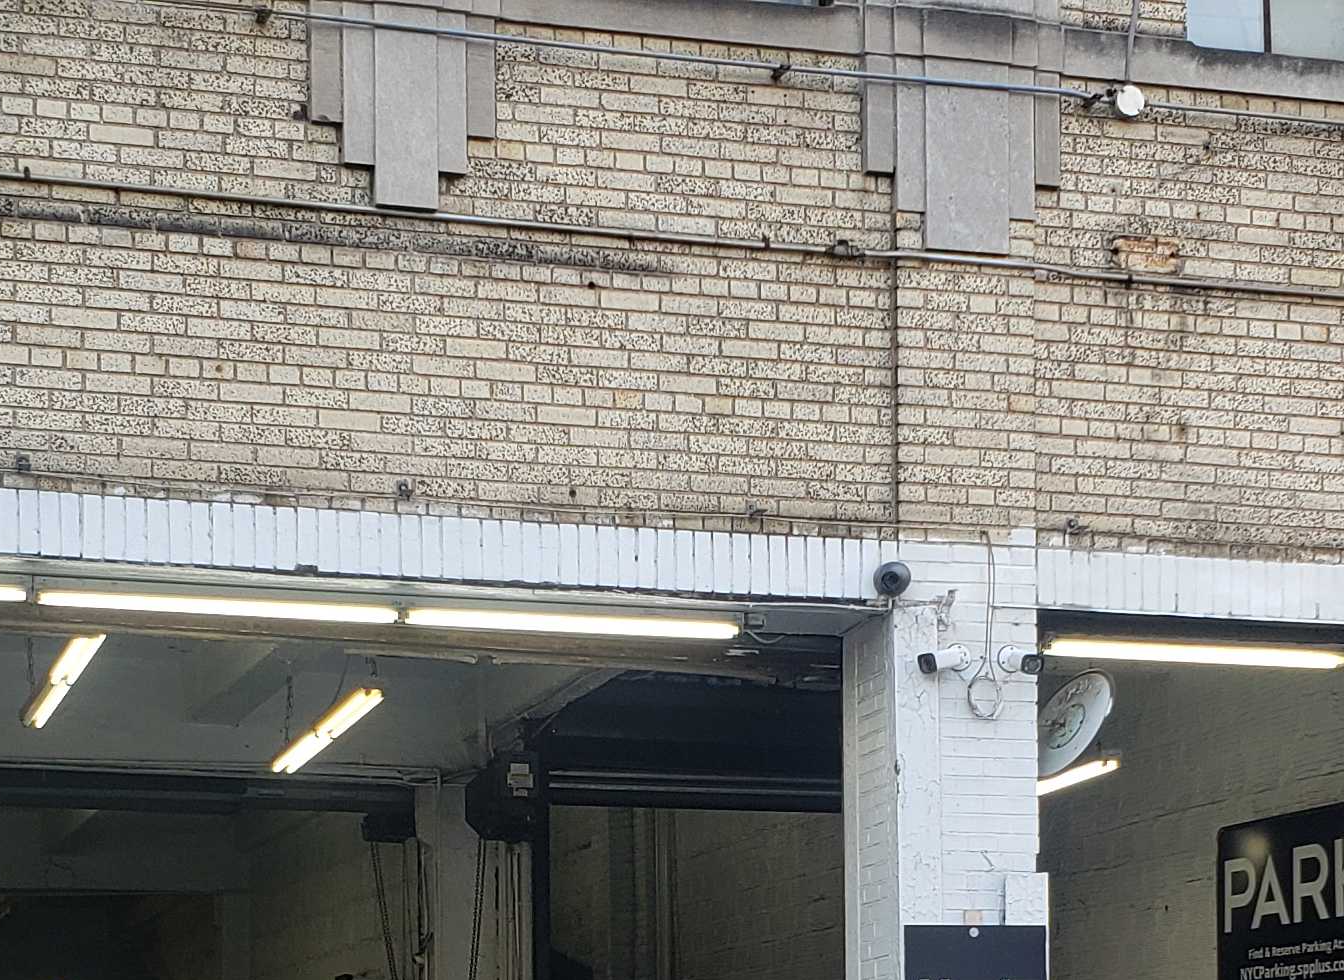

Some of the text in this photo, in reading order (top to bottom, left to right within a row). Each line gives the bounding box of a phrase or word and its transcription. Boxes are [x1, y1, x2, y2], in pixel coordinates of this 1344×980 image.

[1248, 948, 1263, 959] Find
[1272, 944, 1300, 957] Reserve
[1301, 940, 1332, 954] Parking
